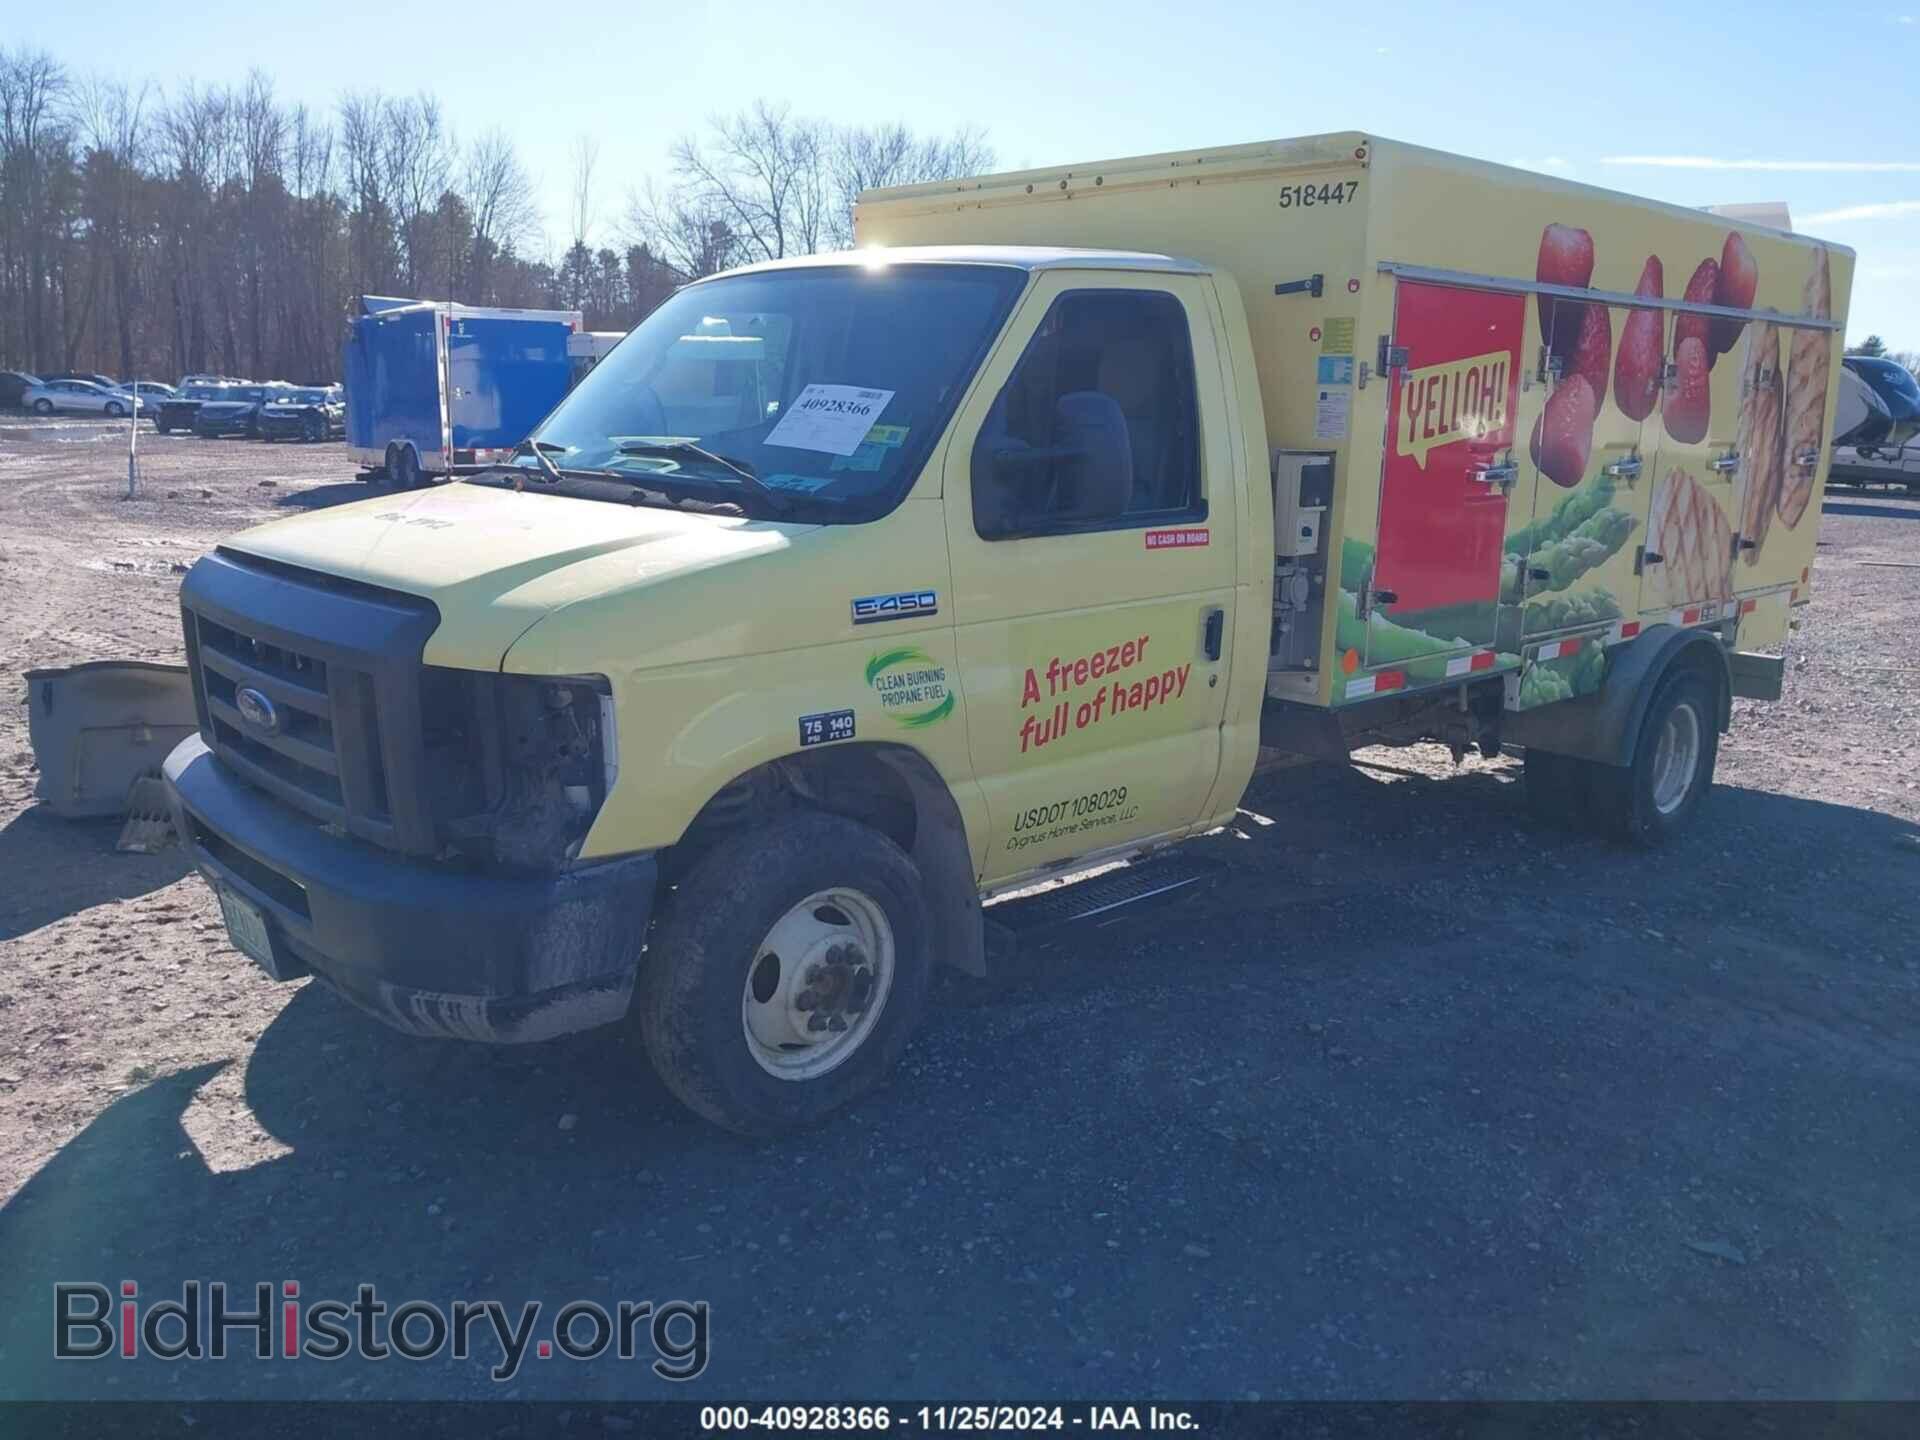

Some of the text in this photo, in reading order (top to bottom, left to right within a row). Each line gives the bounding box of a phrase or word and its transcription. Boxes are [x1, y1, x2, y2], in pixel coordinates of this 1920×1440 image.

[1279, 181, 1359, 209] 518447
[801, 398, 871, 416] 40928366
[1406, 360, 1506, 443] YELLOH!
[876, 667, 946, 691] CLEAN BURNING
[1021, 634, 1150, 708] A freezer
[881, 684, 946, 707] PROPANE FUEL
[1019, 663, 1192, 753] full of happy
[804, 716, 853, 735] 75 140
[1014, 786, 1128, 832] USDOT 108029
[1047, 823, 1078, 839] Home
[1119, 806, 1139, 821] LLC
